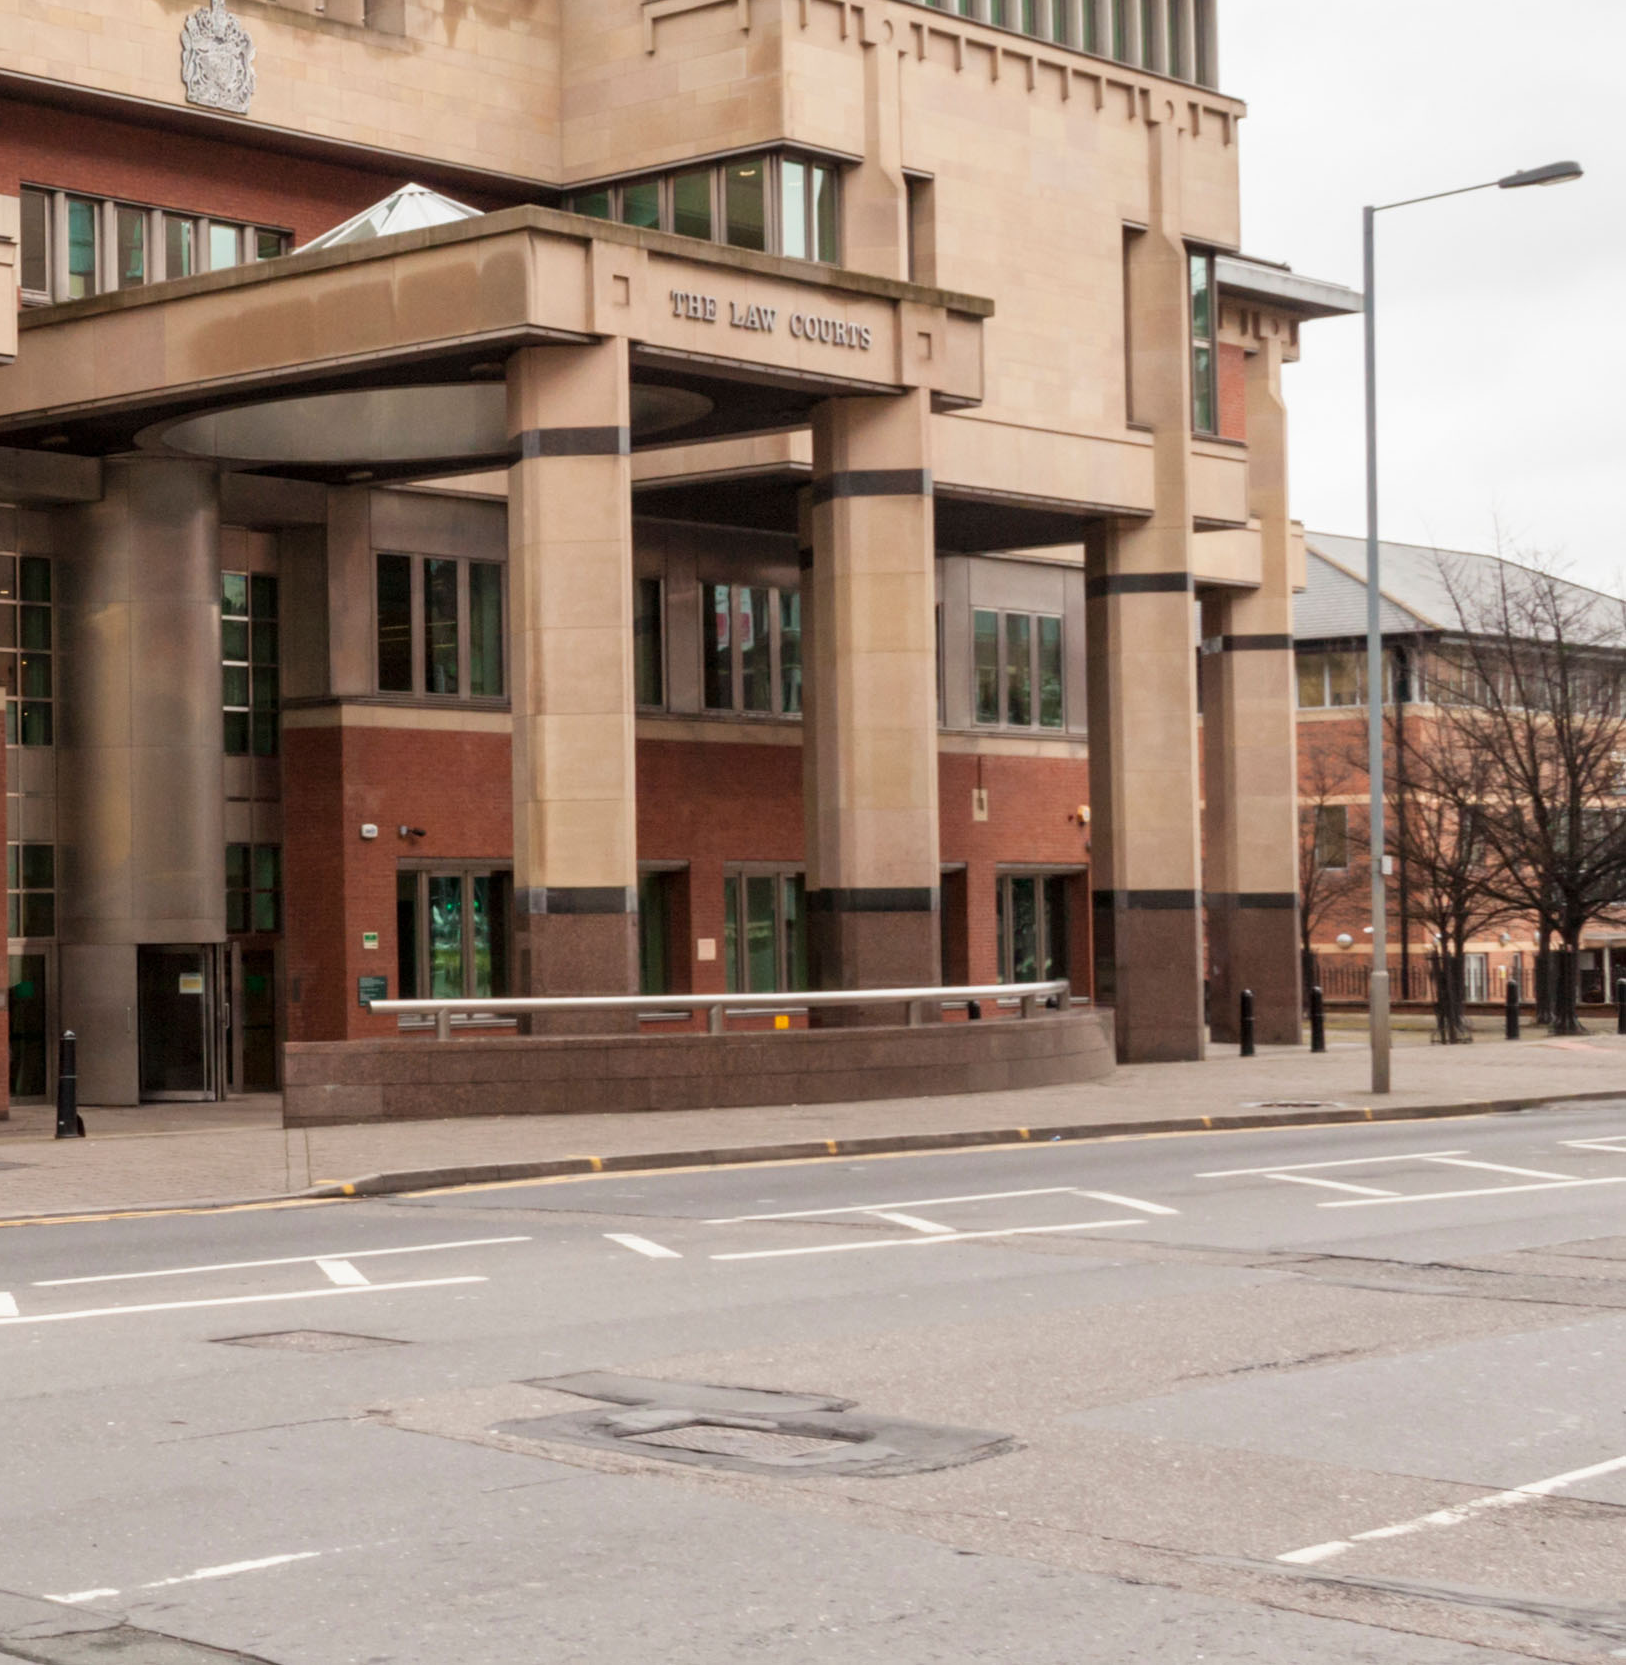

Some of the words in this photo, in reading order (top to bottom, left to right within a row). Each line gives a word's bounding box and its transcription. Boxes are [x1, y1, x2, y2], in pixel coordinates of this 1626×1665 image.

[669, 289, 717, 322] THE
[729, 301, 777, 333] LAW
[790, 313, 872, 350] COURTS
